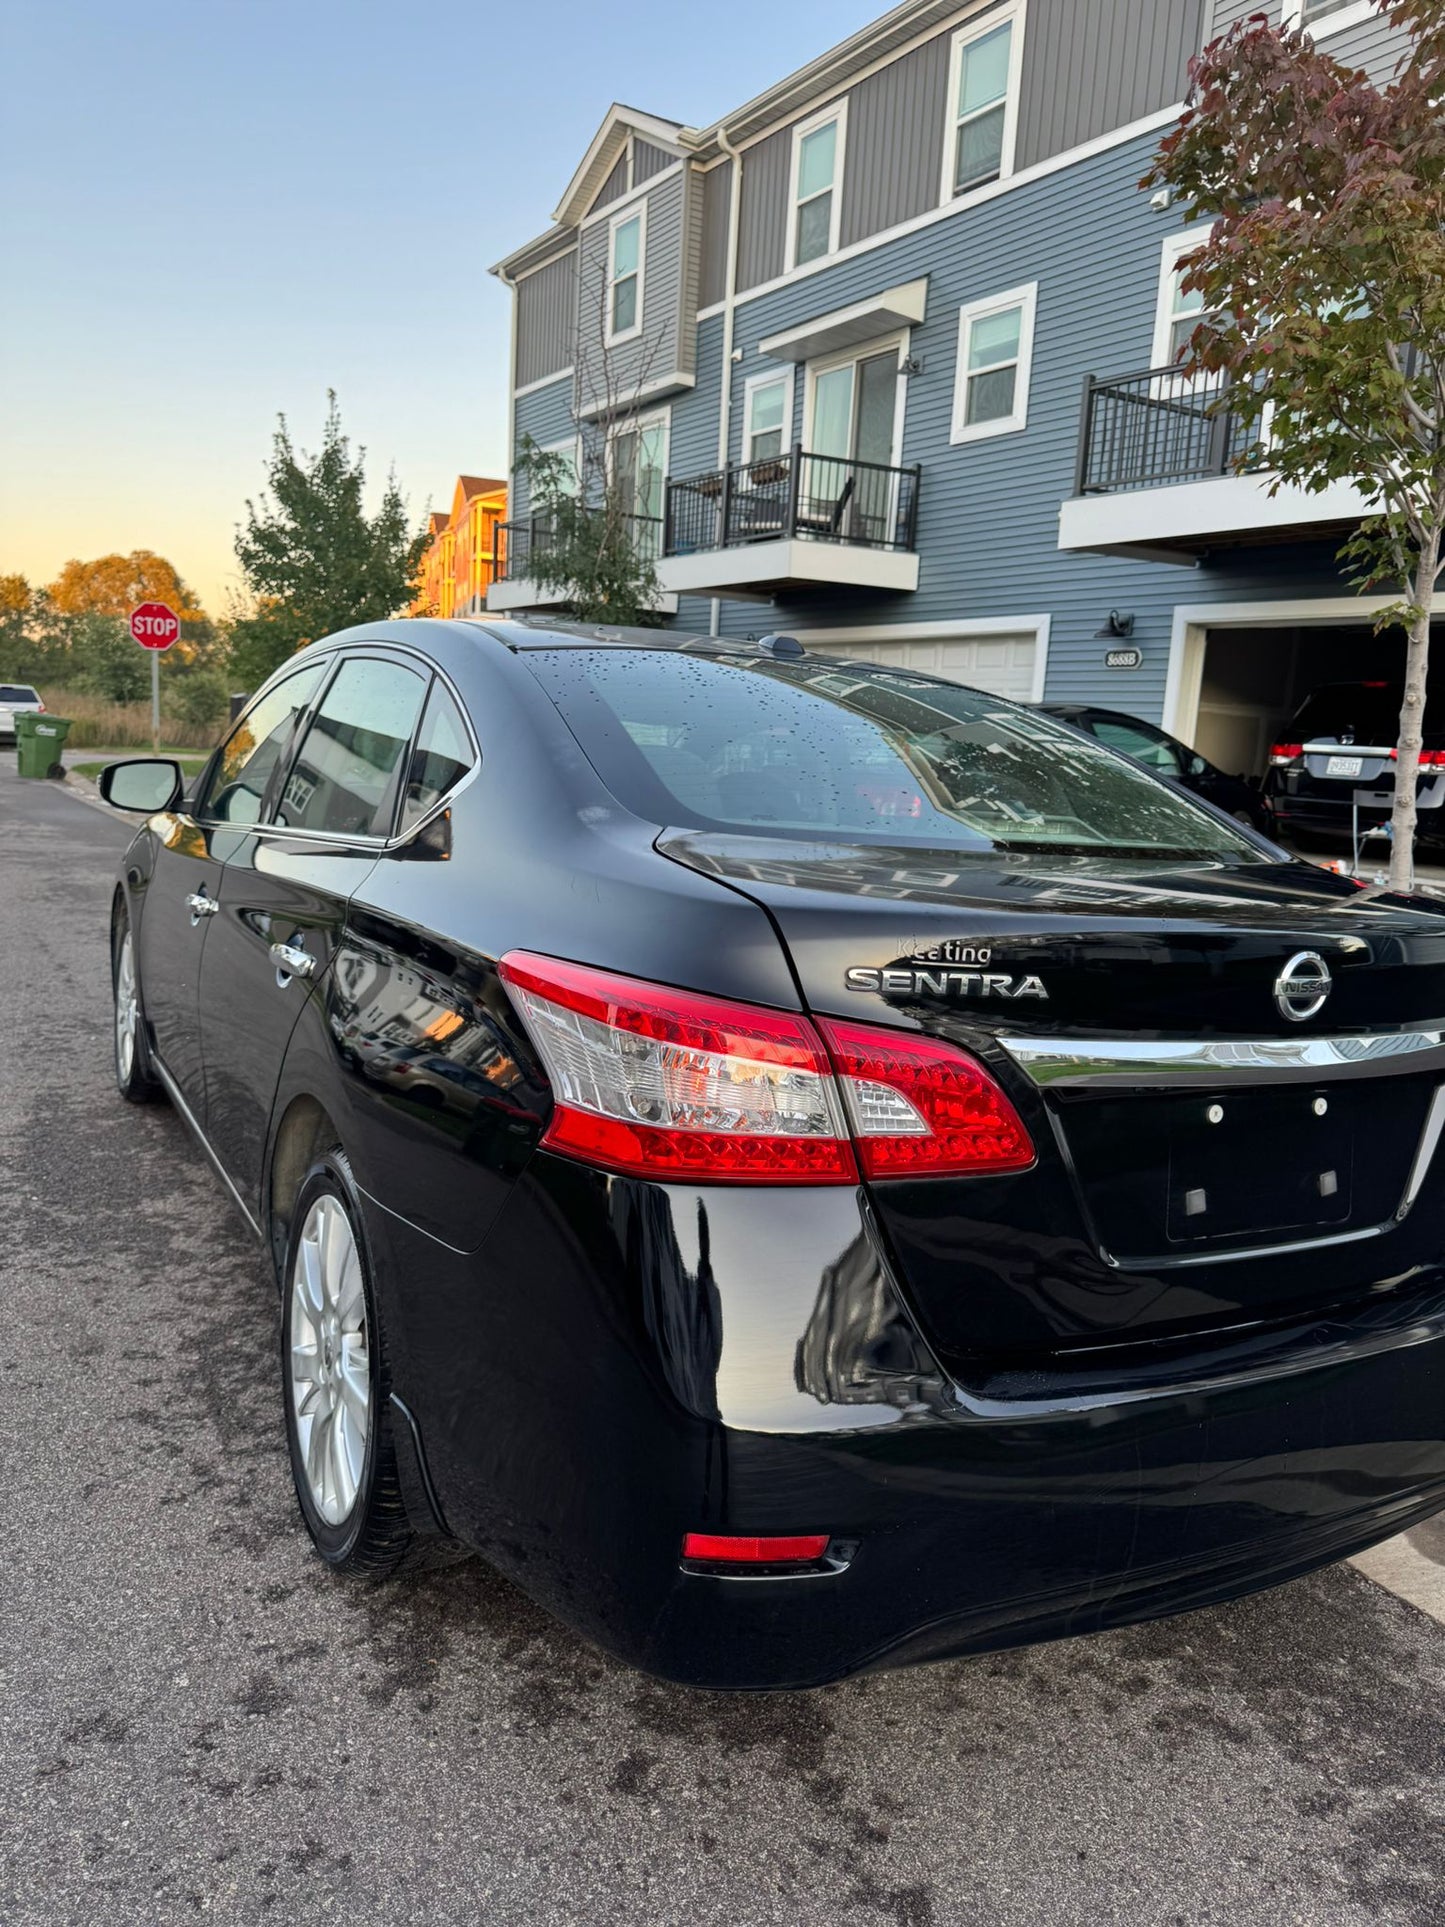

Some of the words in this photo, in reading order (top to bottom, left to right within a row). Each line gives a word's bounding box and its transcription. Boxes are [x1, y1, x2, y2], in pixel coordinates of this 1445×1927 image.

[133, 615, 177, 637] STOP
[898, 938, 992, 968] Keating
[846, 967, 1050, 999] SENTRA
[1284, 981, 1330, 993] NISSAN
